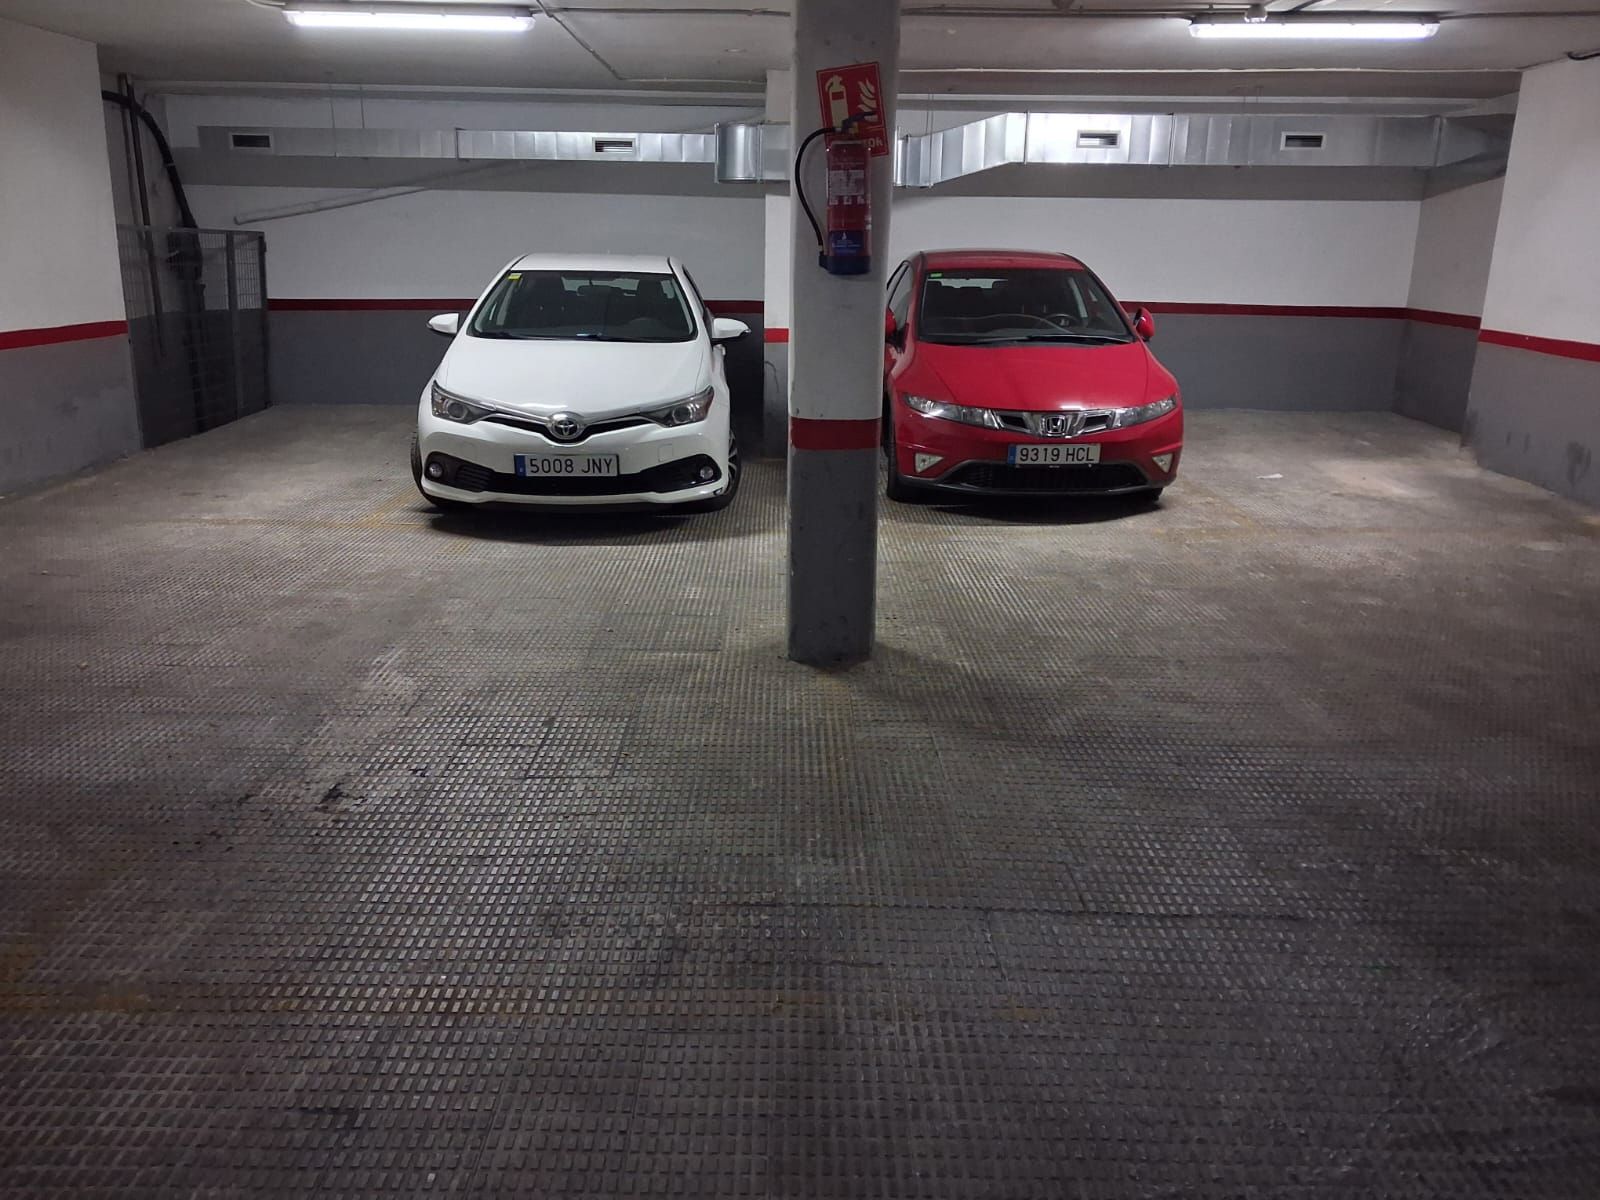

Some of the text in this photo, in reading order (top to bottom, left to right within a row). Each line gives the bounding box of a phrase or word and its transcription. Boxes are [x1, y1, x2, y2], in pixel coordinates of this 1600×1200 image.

[1019, 447, 1095, 462] 9319 HCL
[529, 458, 574, 474] 5008
[582, 458, 613, 474] JNY
